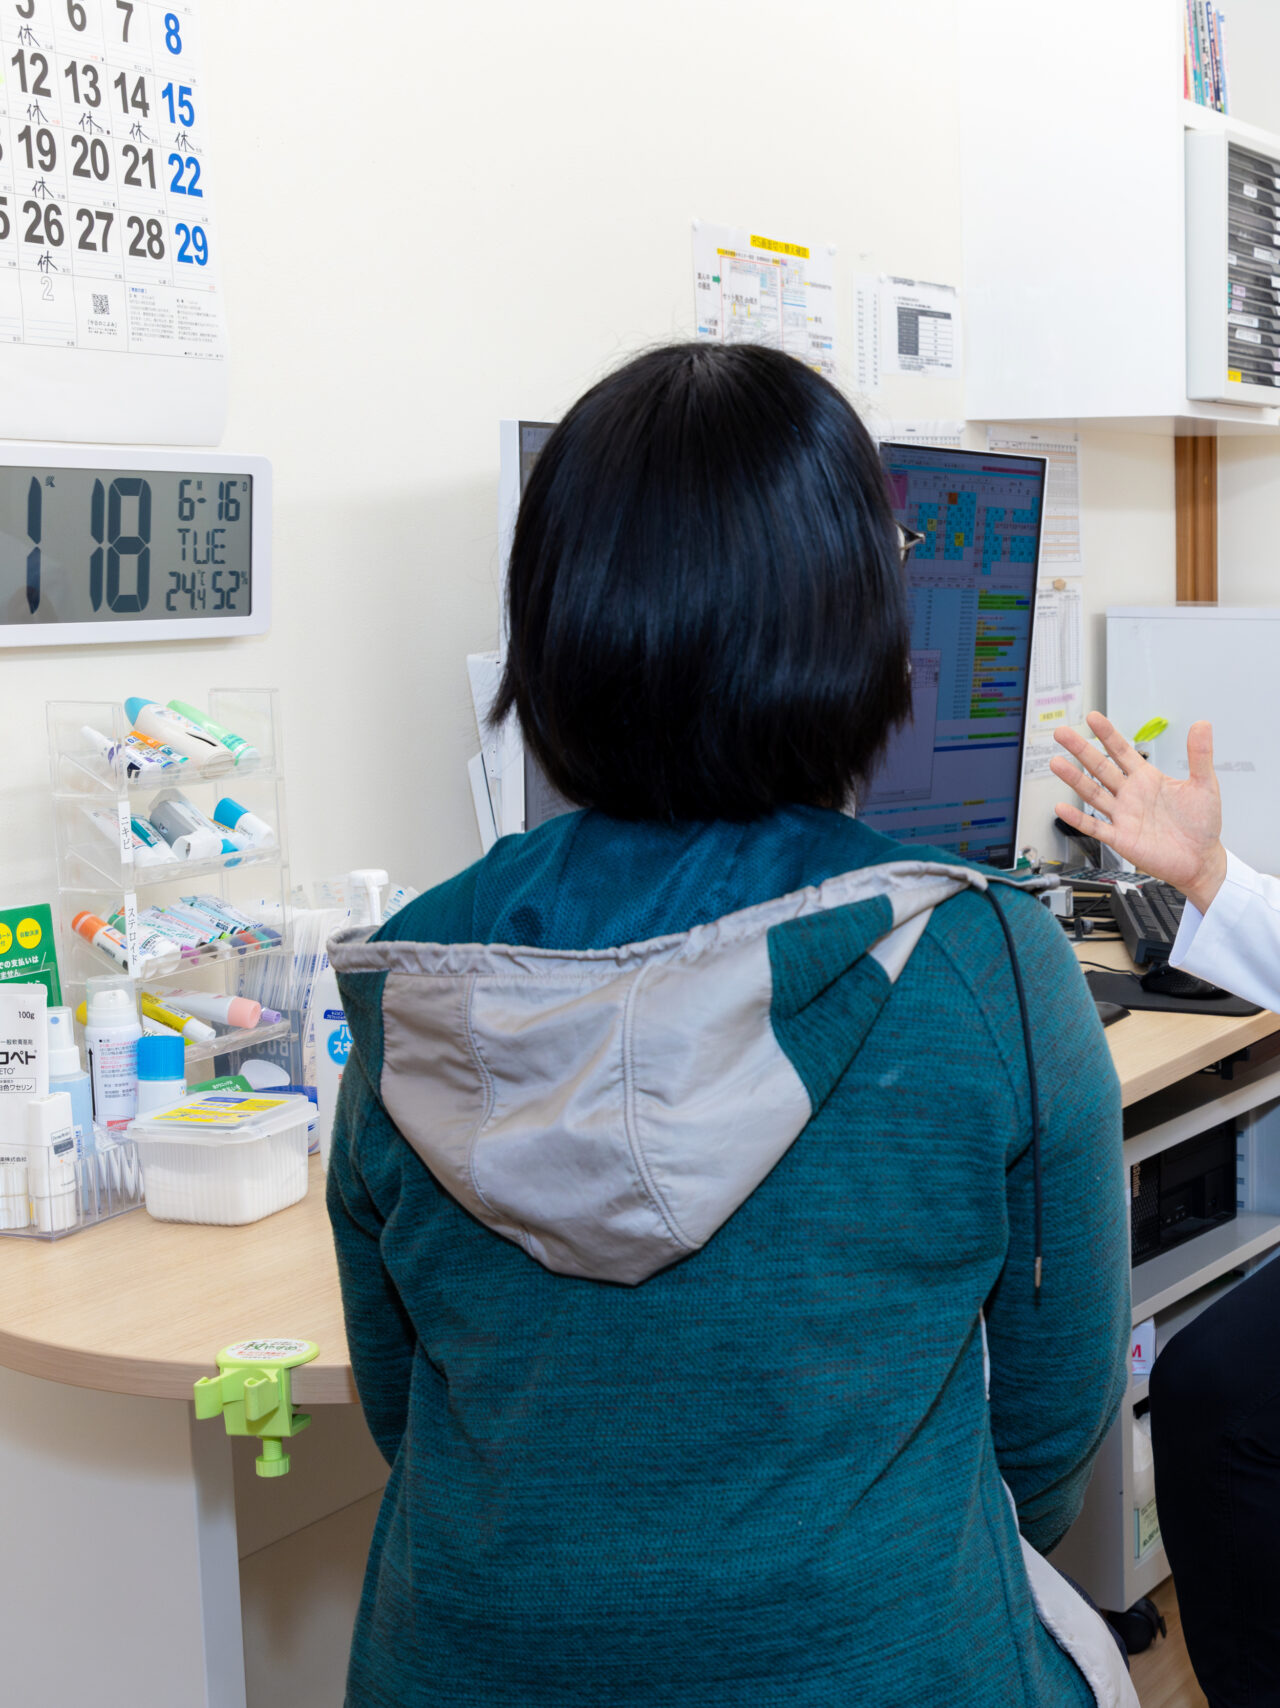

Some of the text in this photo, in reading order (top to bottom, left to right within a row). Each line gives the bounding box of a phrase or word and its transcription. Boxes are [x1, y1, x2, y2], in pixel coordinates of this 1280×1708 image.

[18, 24, 40, 47] 休
[116, 0, 133, 42] 7
[164, 13, 182, 55] 8
[12, 49, 195, 128] 12 13 14 15
[27, 98, 194, 152] 休 休 休 休
[18, 124, 203, 198] 19 20 21 22
[32, 176, 54, 200] 休
[22, 200, 64, 247] 26
[76, 208, 114, 253] 27
[127, 216, 165, 260] 28
[175, 223, 208, 266] 29
[38, 250, 58, 274] 休
[40, 275, 55, 301] 2
[27, 476, 151, 614] 1 18
[177, 528, 226, 565] TUE
[121, 816, 130, 850] ニキビ
[128, 907, 137, 965] ステロイド
[18, 1011, 35, 1020] 100g
